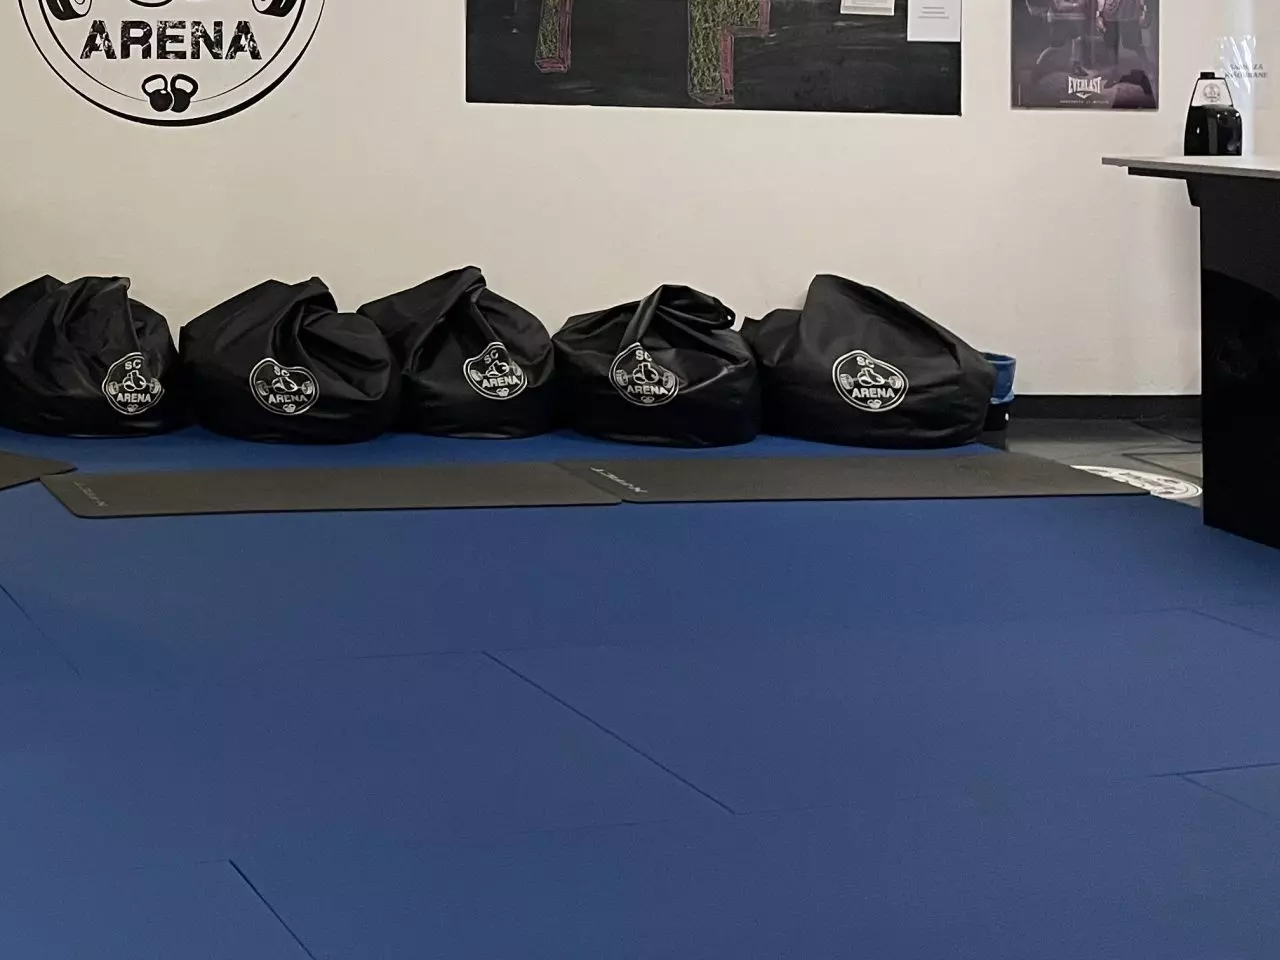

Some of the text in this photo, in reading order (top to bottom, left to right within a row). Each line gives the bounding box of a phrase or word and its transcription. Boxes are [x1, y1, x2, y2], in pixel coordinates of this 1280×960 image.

[79, 19, 262, 60] ARENA
[1068, 76, 1102, 94] EVERLAST
[124, 359, 141, 370] SC
[856, 356, 874, 368] SC
[482, 375, 521, 388] ARENA
[627, 385, 668, 396] ARENA
[852, 387, 895, 398] ARENA
[116, 392, 151, 403] ARENA
[268, 394, 308, 404] ARENA
